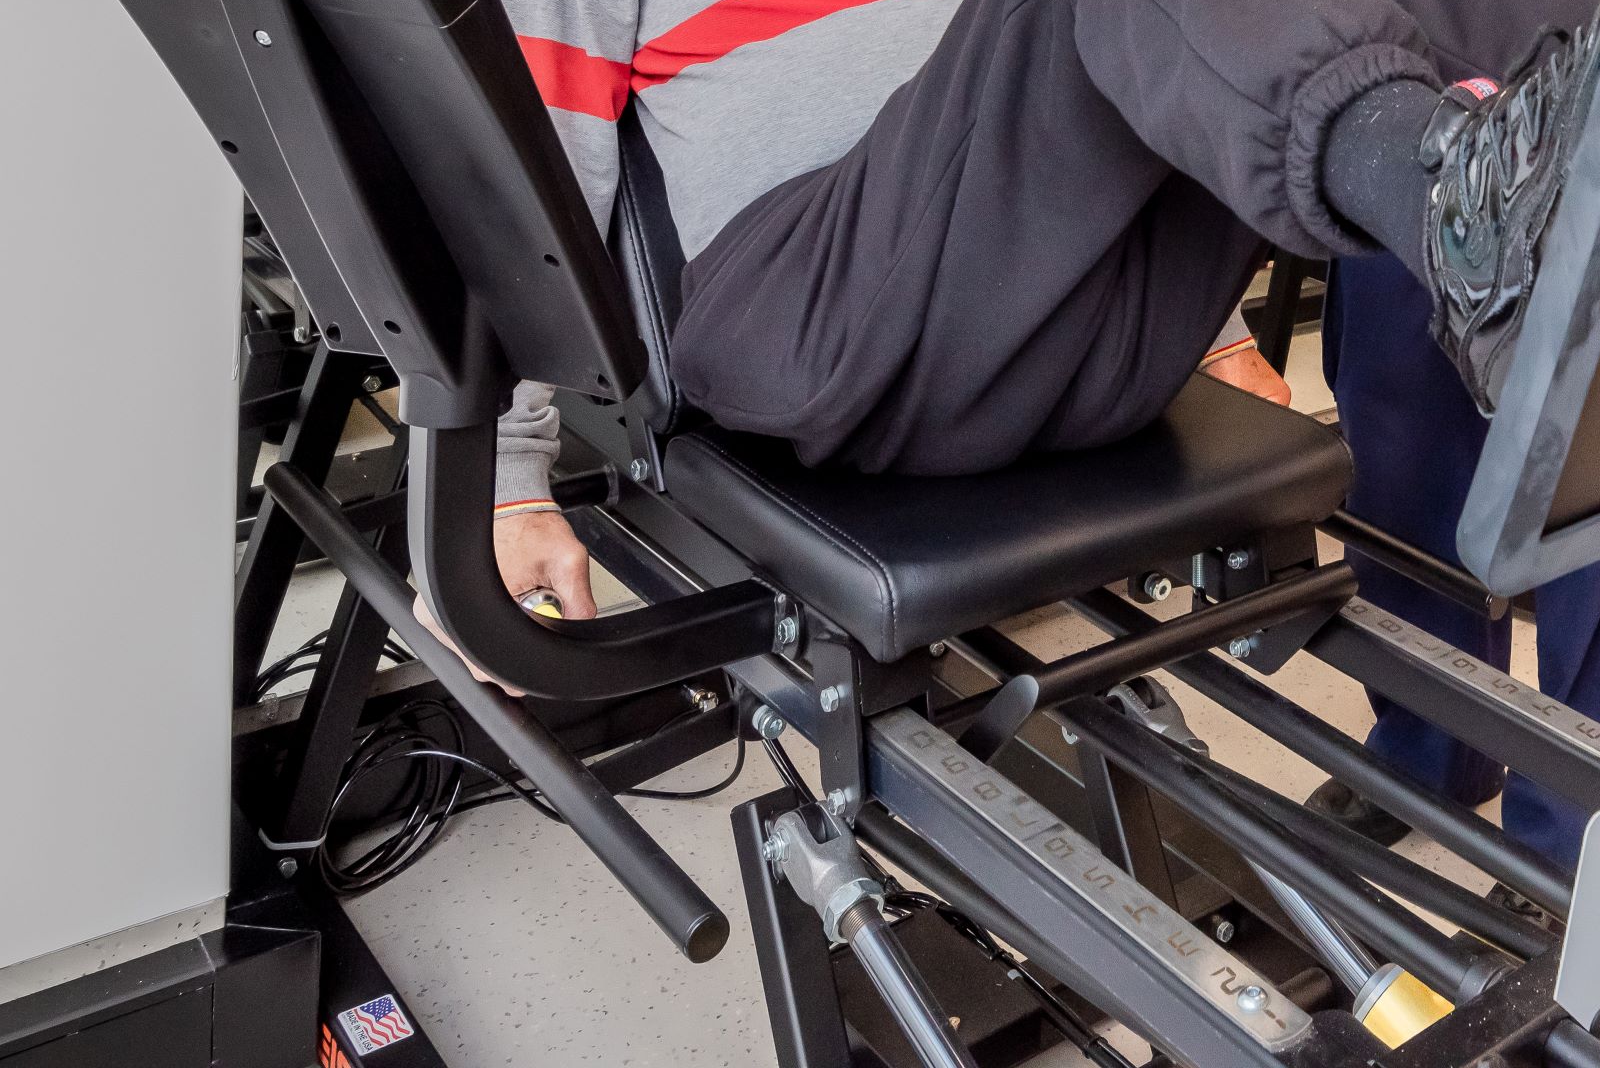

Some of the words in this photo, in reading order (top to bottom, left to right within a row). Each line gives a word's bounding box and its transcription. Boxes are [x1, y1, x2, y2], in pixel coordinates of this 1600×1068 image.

[973, 782, 1003, 801] 8
[1082, 866, 1116, 889] 5
[1168, 931, 1200, 957] 3
[1210, 966, 1246, 996] 2
[345, 1010, 359, 1025] MADE
[356, 1029, 368, 1041] THE
[362, 1037, 374, 1052] USA
